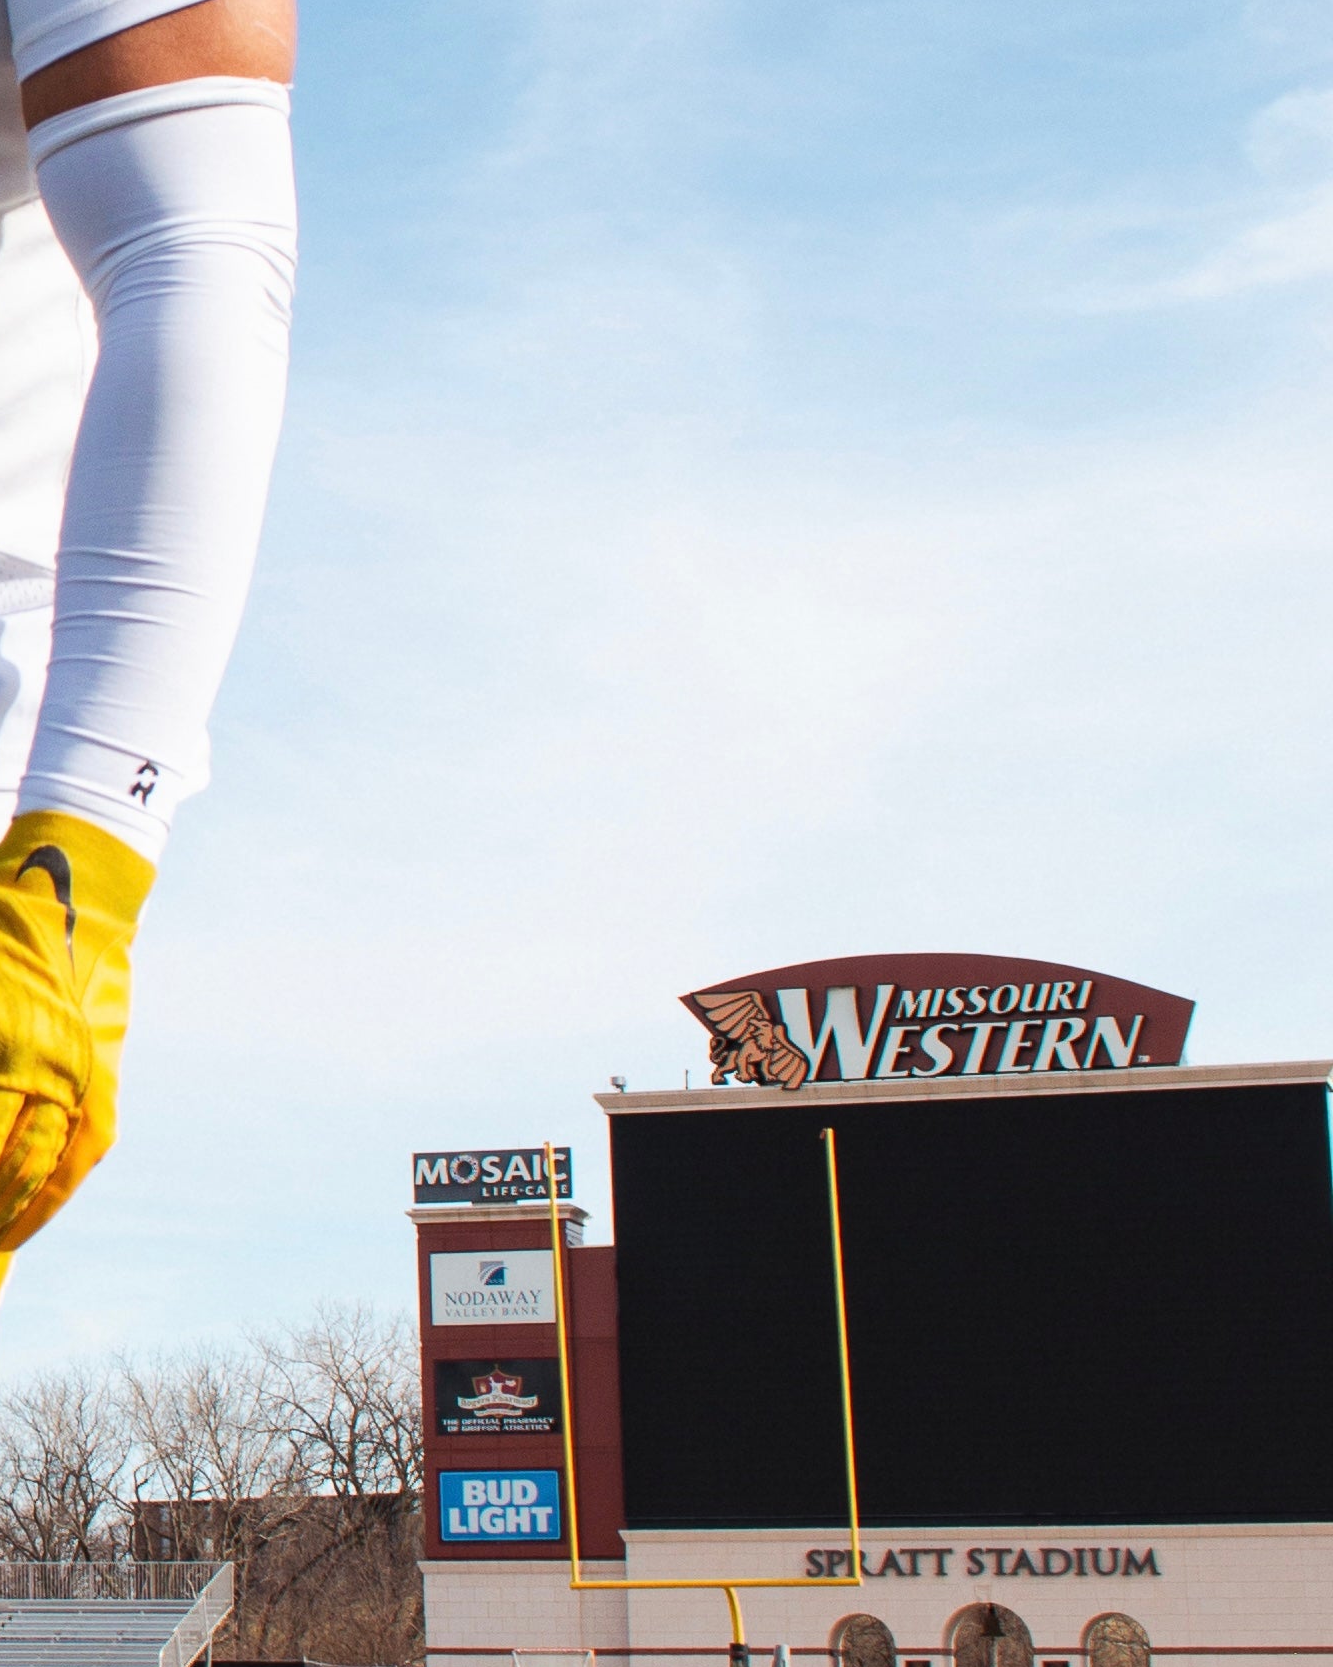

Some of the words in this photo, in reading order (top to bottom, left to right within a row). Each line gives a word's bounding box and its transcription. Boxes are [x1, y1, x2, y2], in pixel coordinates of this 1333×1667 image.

[895, 980, 1093, 1020] MISSOURI
[776, 983, 1145, 1083] WESTERN
[415, 1152, 568, 1186] MOSAIC
[524, 1184, 569, 1196] CAE
[444, 1289, 542, 1307] NODAWAY
[444, 1307, 498, 1318] VALLEY
[501, 1306, 541, 1317] BANK
[442, 1418, 459, 1426] THE
[461, 1478, 539, 1507] BUD
[448, 1506, 553, 1534] LIGHT
[805, 1547, 953, 1578] SPRATT
[966, 1546, 1162, 1577] STADIUM
